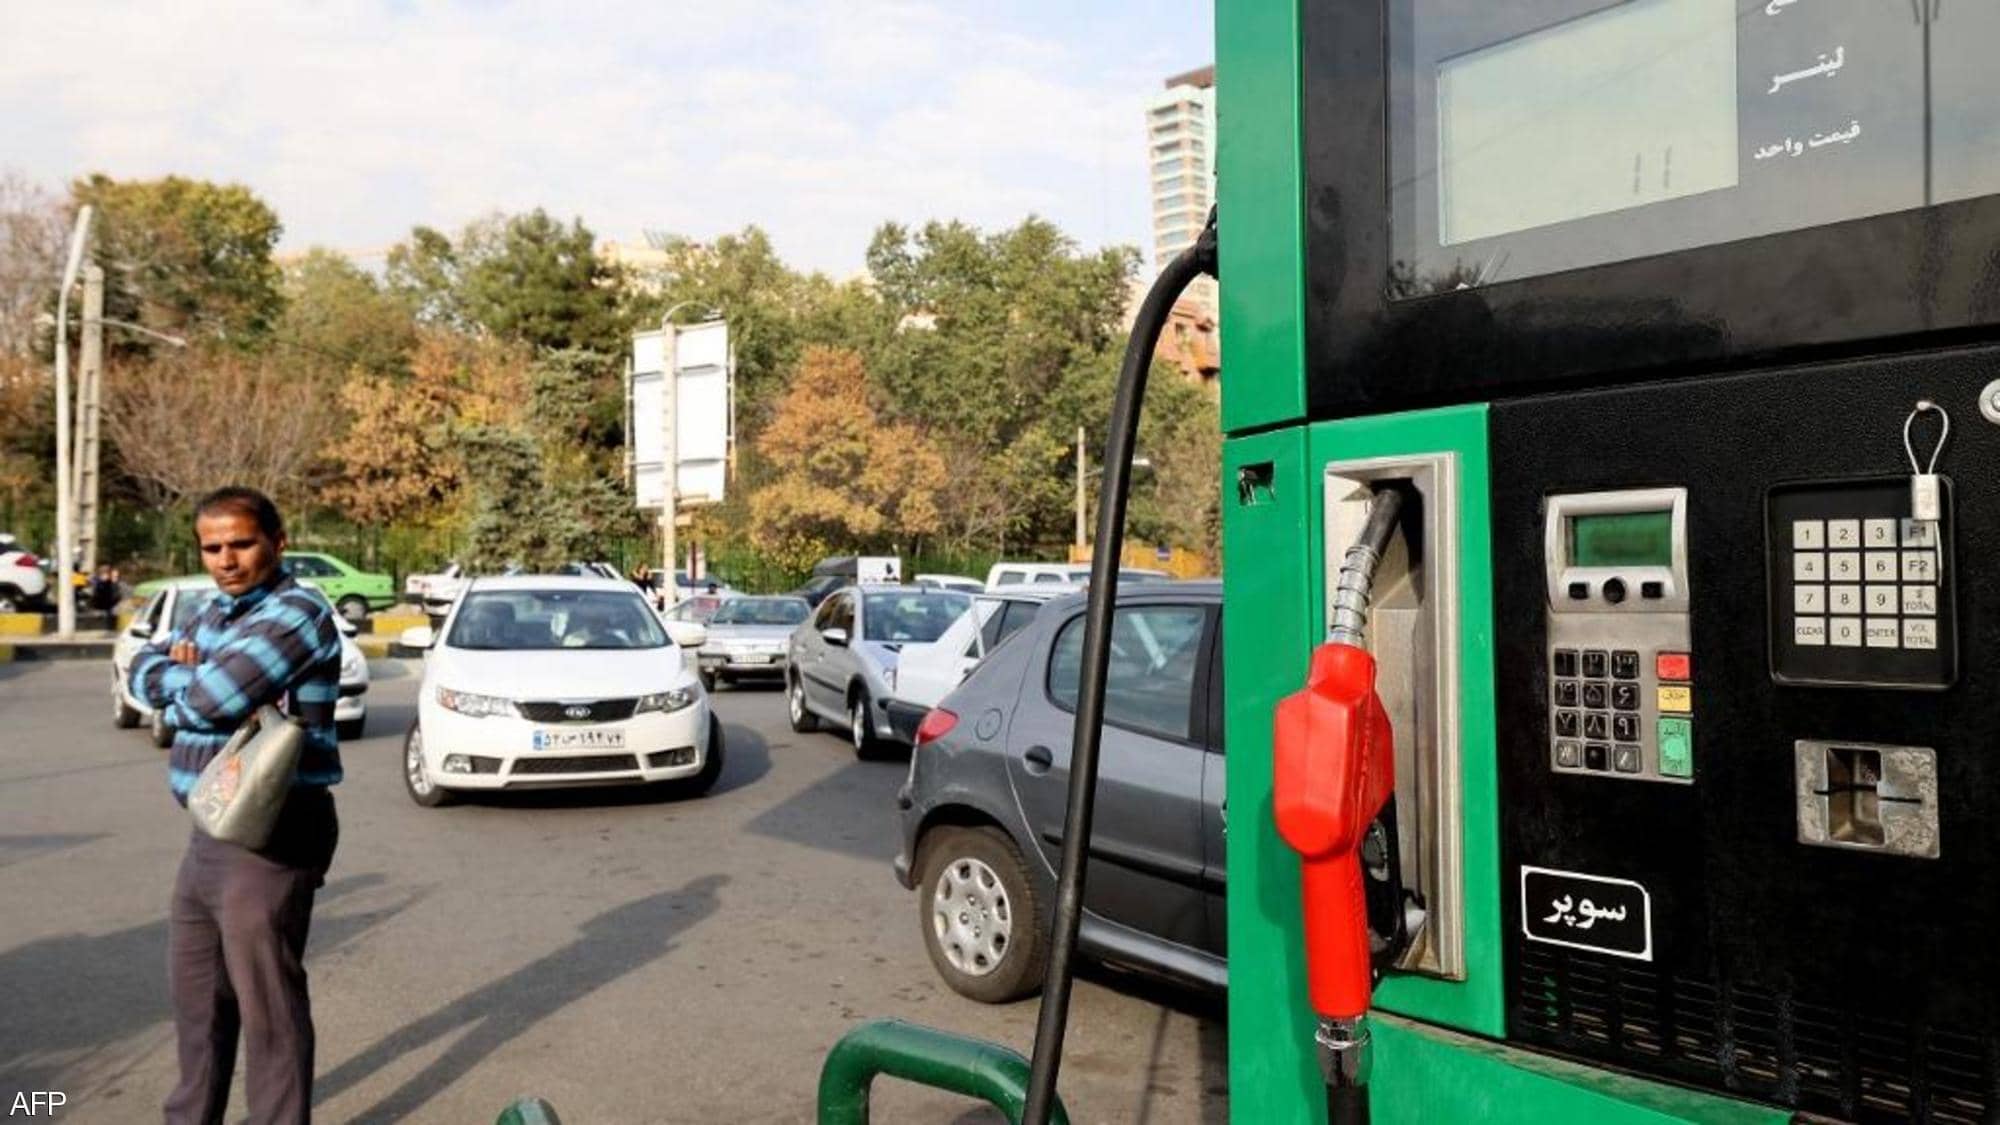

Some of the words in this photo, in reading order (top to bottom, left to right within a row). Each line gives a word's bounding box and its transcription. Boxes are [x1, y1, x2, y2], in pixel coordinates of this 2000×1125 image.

[1768, 46, 1844, 94] لیتر
[1808, 120, 1860, 147] قیمت
[1754, 137, 1803, 159] واحد
[1804, 529, 1810, 541] 1
[1839, 528, 1849, 540] 2
[1875, 527, 1885, 540] 3
[1804, 561, 1814, 572] 4
[1840, 560, 1849, 573] 5
[1876, 560, 1886, 573] 6
[1805, 592, 1814, 604] 7
[1841, 592, 1850, 606] 8
[1876, 592, 1886, 606] 9
[1841, 625, 1850, 638] 0
[1618, 686, 1631, 705] ۶
[1618, 718, 1629, 736] ۹
[1542, 894, 1626, 930] سوپر
